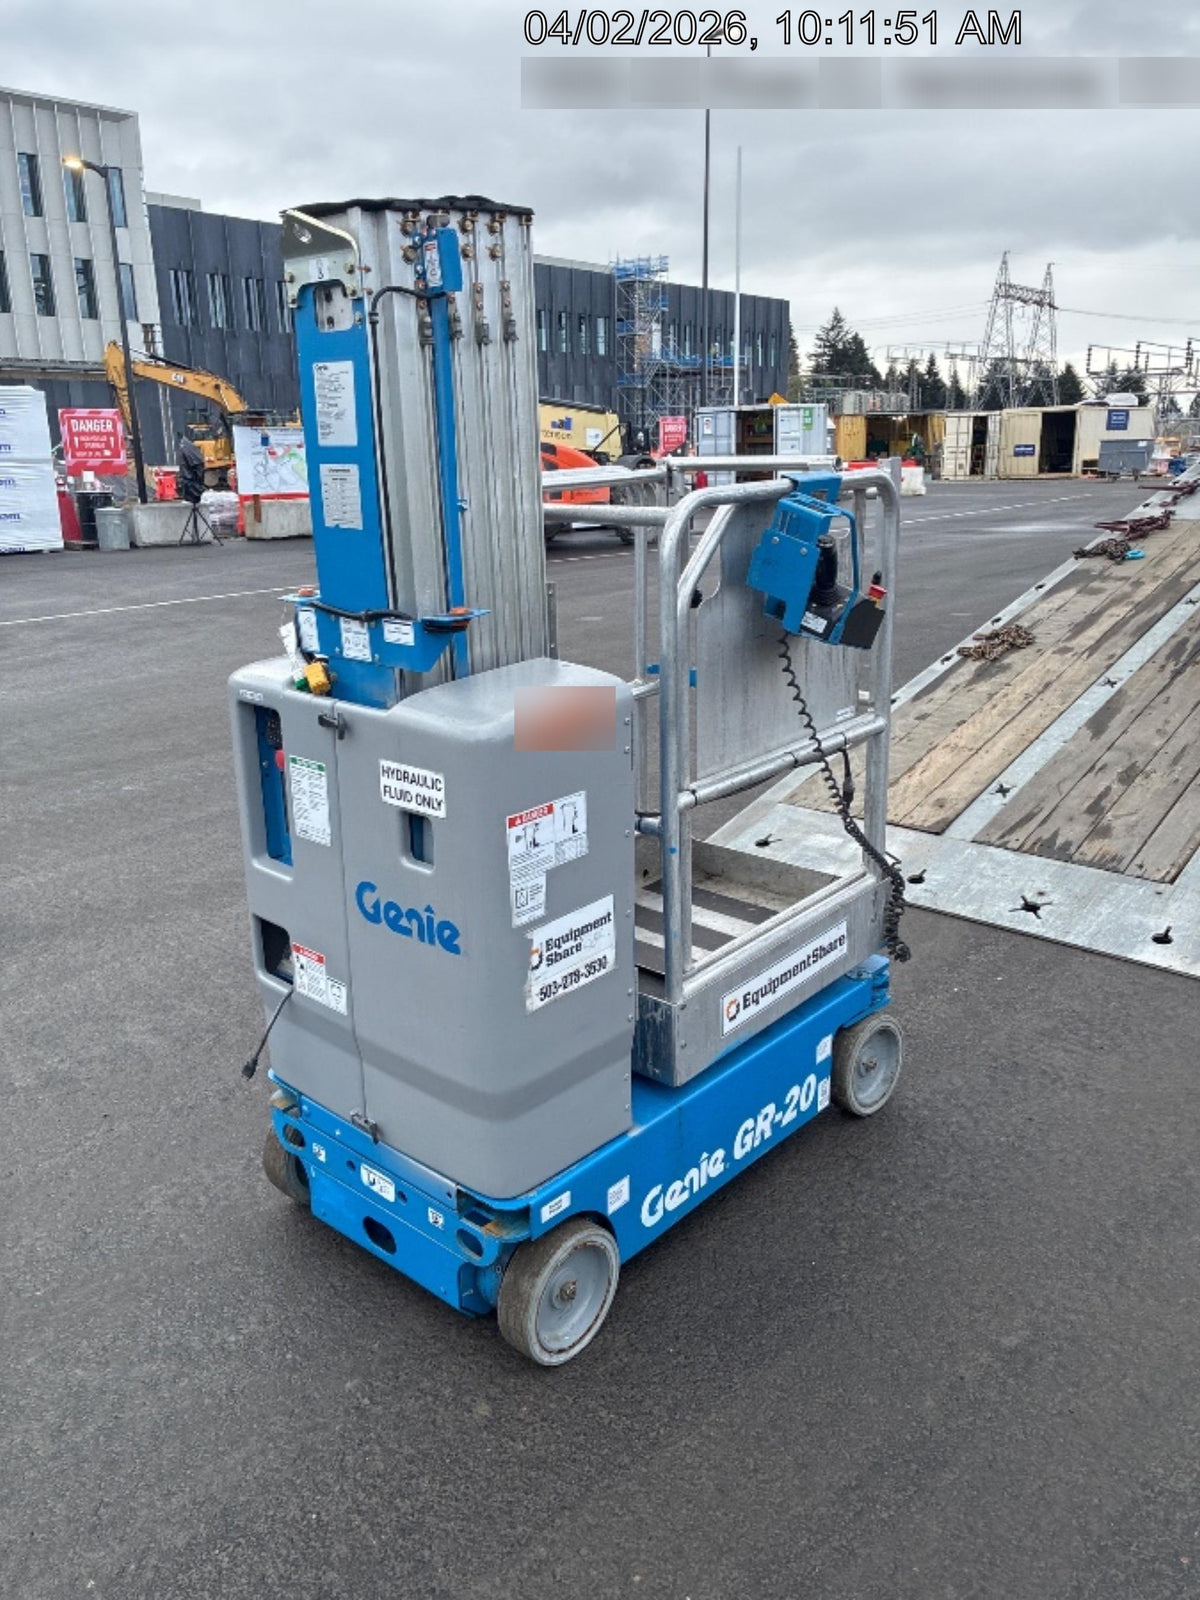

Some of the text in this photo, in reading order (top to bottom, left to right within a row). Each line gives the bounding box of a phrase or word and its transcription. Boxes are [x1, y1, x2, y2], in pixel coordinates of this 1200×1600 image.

[70, 419, 114, 432] DANGER
[381, 765, 442, 792] HYDRAULIC
[383, 785, 443, 811] FLUID ONLY
[356, 881, 461, 955] Genie
[545, 911, 612, 953] Equipment
[545, 942, 583, 968] Share
[742, 934, 846, 1010] EquipmentShare
[640, 1073, 817, 1227] Genie GR-20
